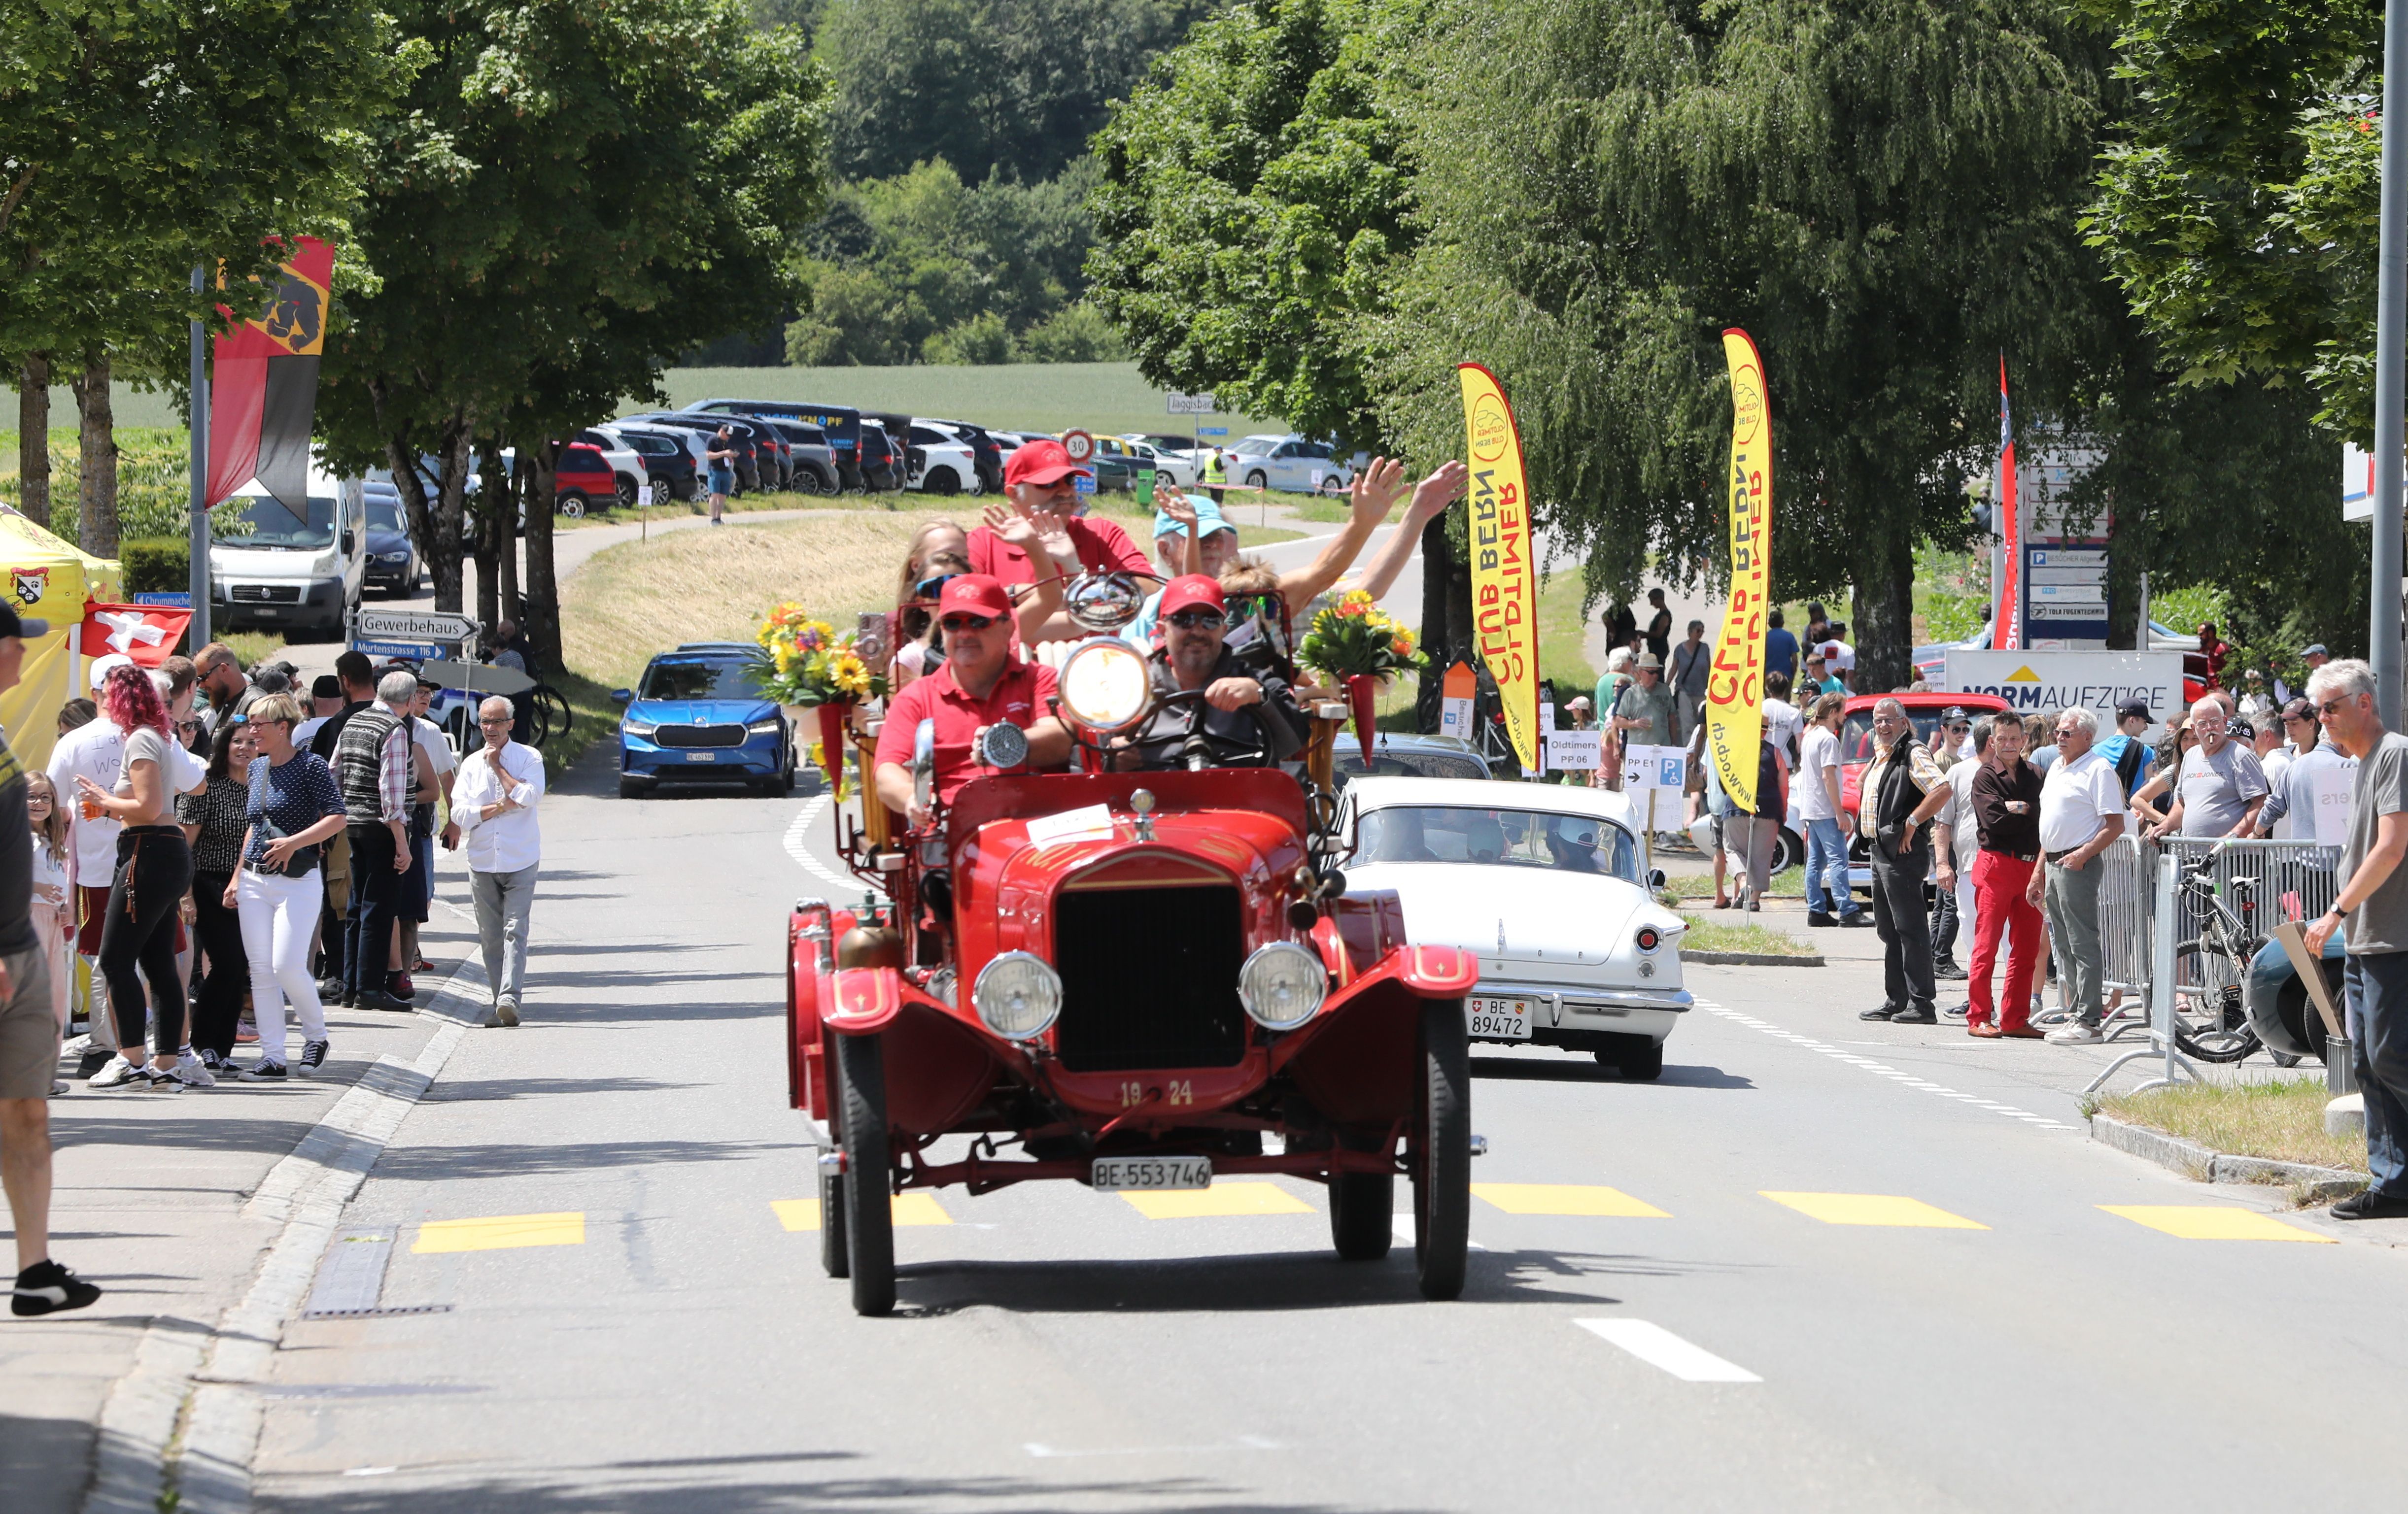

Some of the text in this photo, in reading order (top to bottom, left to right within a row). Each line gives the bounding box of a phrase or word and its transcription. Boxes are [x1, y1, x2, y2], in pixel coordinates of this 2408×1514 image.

[1071, 441, 1084, 452] 30
[145, 595, 190, 606] Chrummache
[365, 616, 459, 635] Gewerbehaus
[357, 642, 431, 657] Murtenstrasse 116
[1962, 685, 2167, 708] RMAUFZÜGE
[1457, 700, 1467, 737] Besuche
[1551, 740, 1597, 749] Oldtimers
[1490, 1001, 1507, 1014] BE
[1472, 1016, 1523, 1035] 89472
[1121, 1079, 1193, 1107] 19 24
